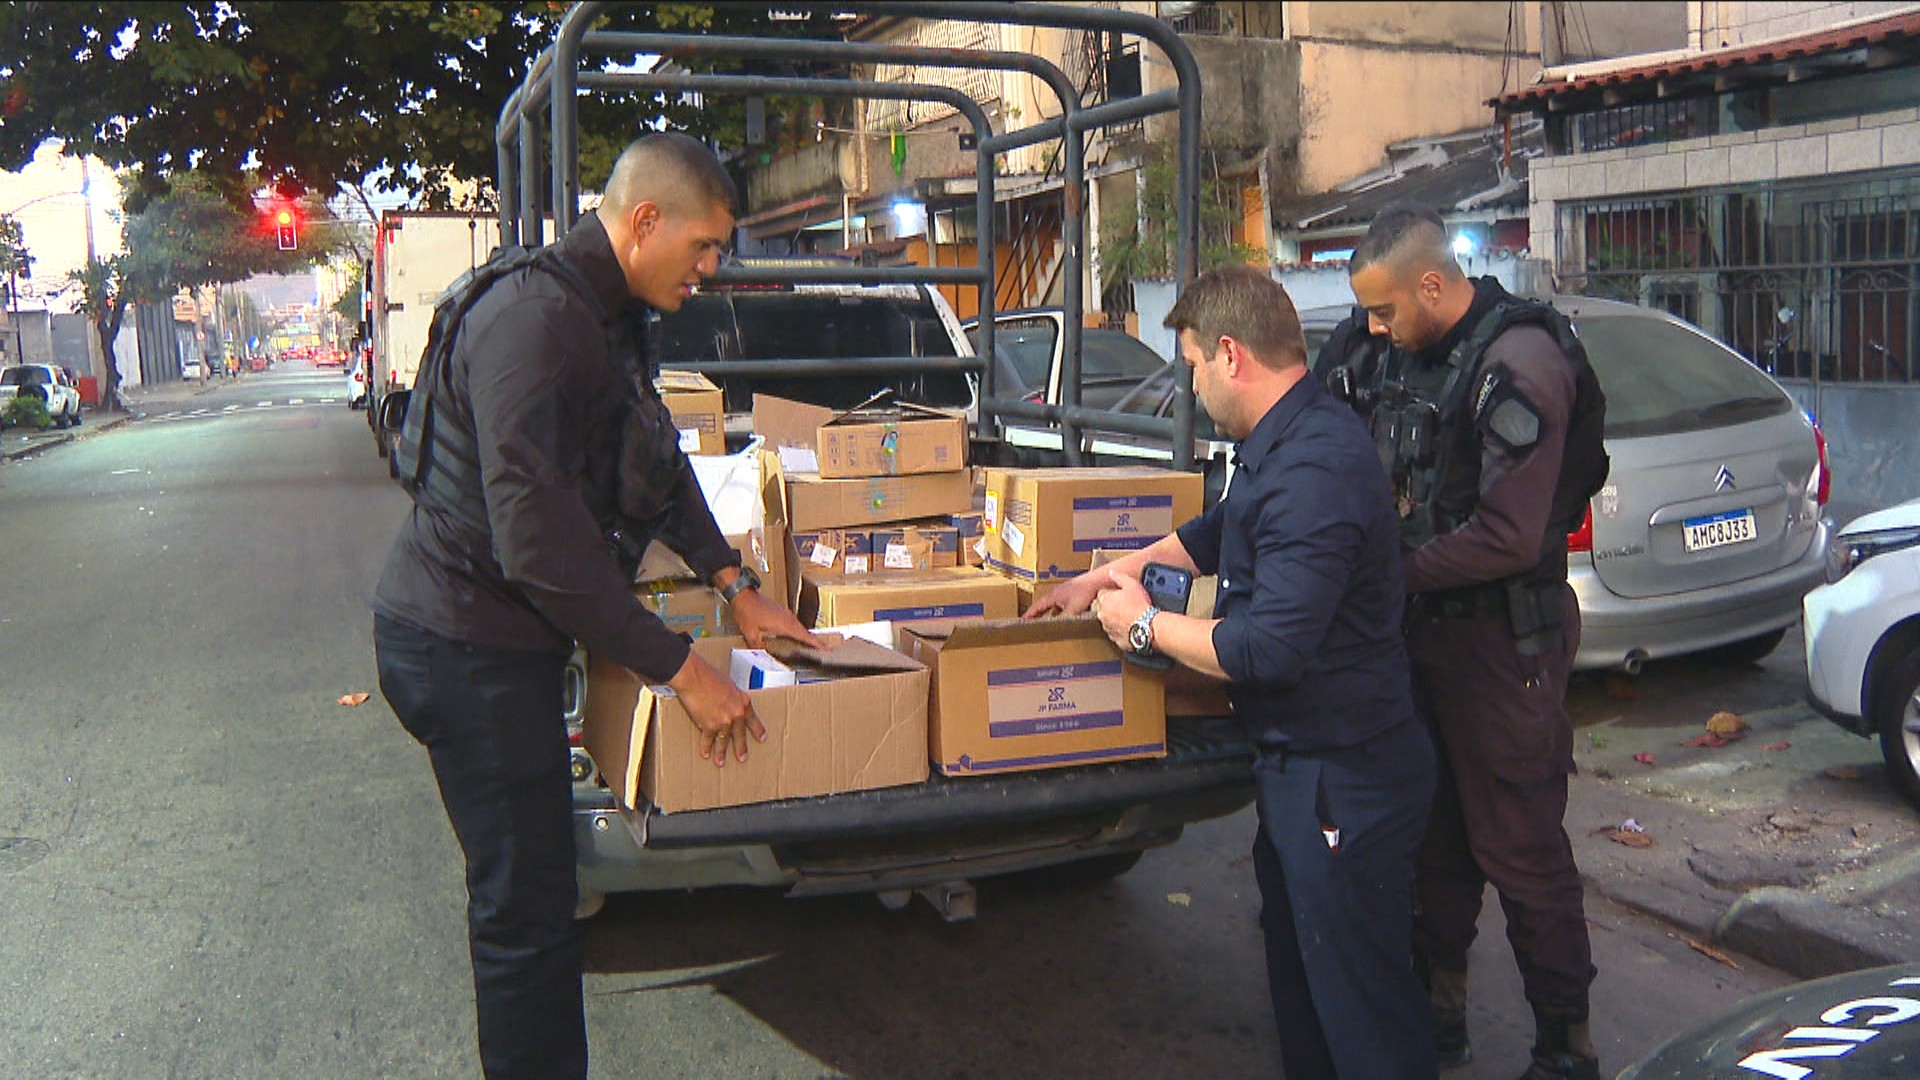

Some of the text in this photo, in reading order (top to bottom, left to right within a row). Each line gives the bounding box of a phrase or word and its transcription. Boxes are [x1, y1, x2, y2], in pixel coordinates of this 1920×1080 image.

[1693, 519, 1748, 548] AMC8J33
[1038, 701, 1076, 712] JP FARMA
